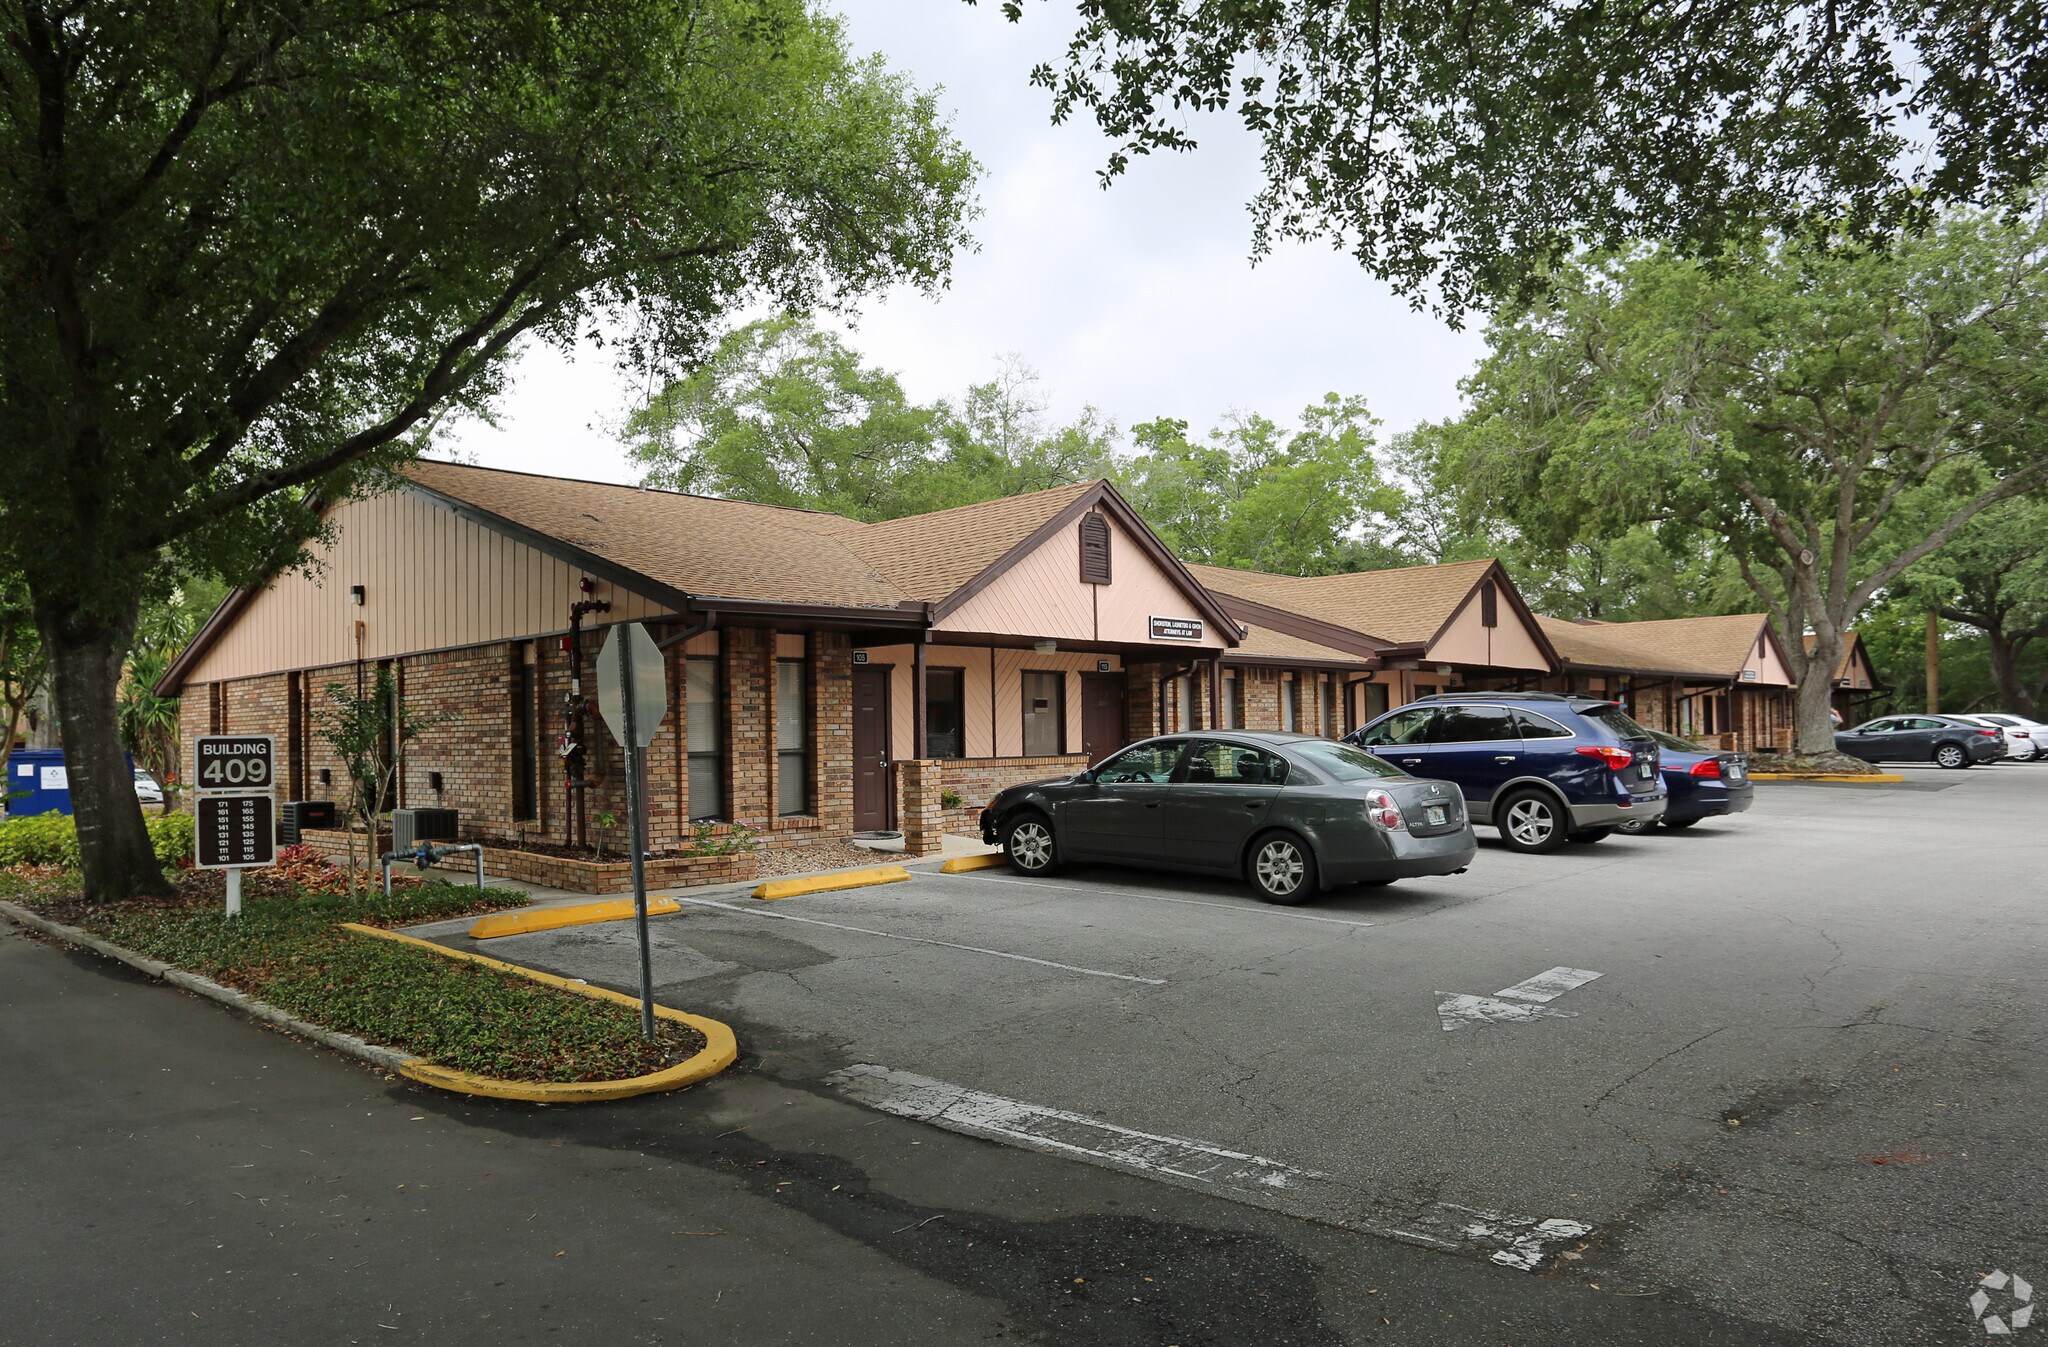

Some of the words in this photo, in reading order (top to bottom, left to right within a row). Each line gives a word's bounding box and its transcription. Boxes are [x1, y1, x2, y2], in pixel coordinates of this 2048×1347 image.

[856, 653, 865, 661] 105
[203, 743, 266, 755] BUILDING
[203, 758, 267, 783] 409
